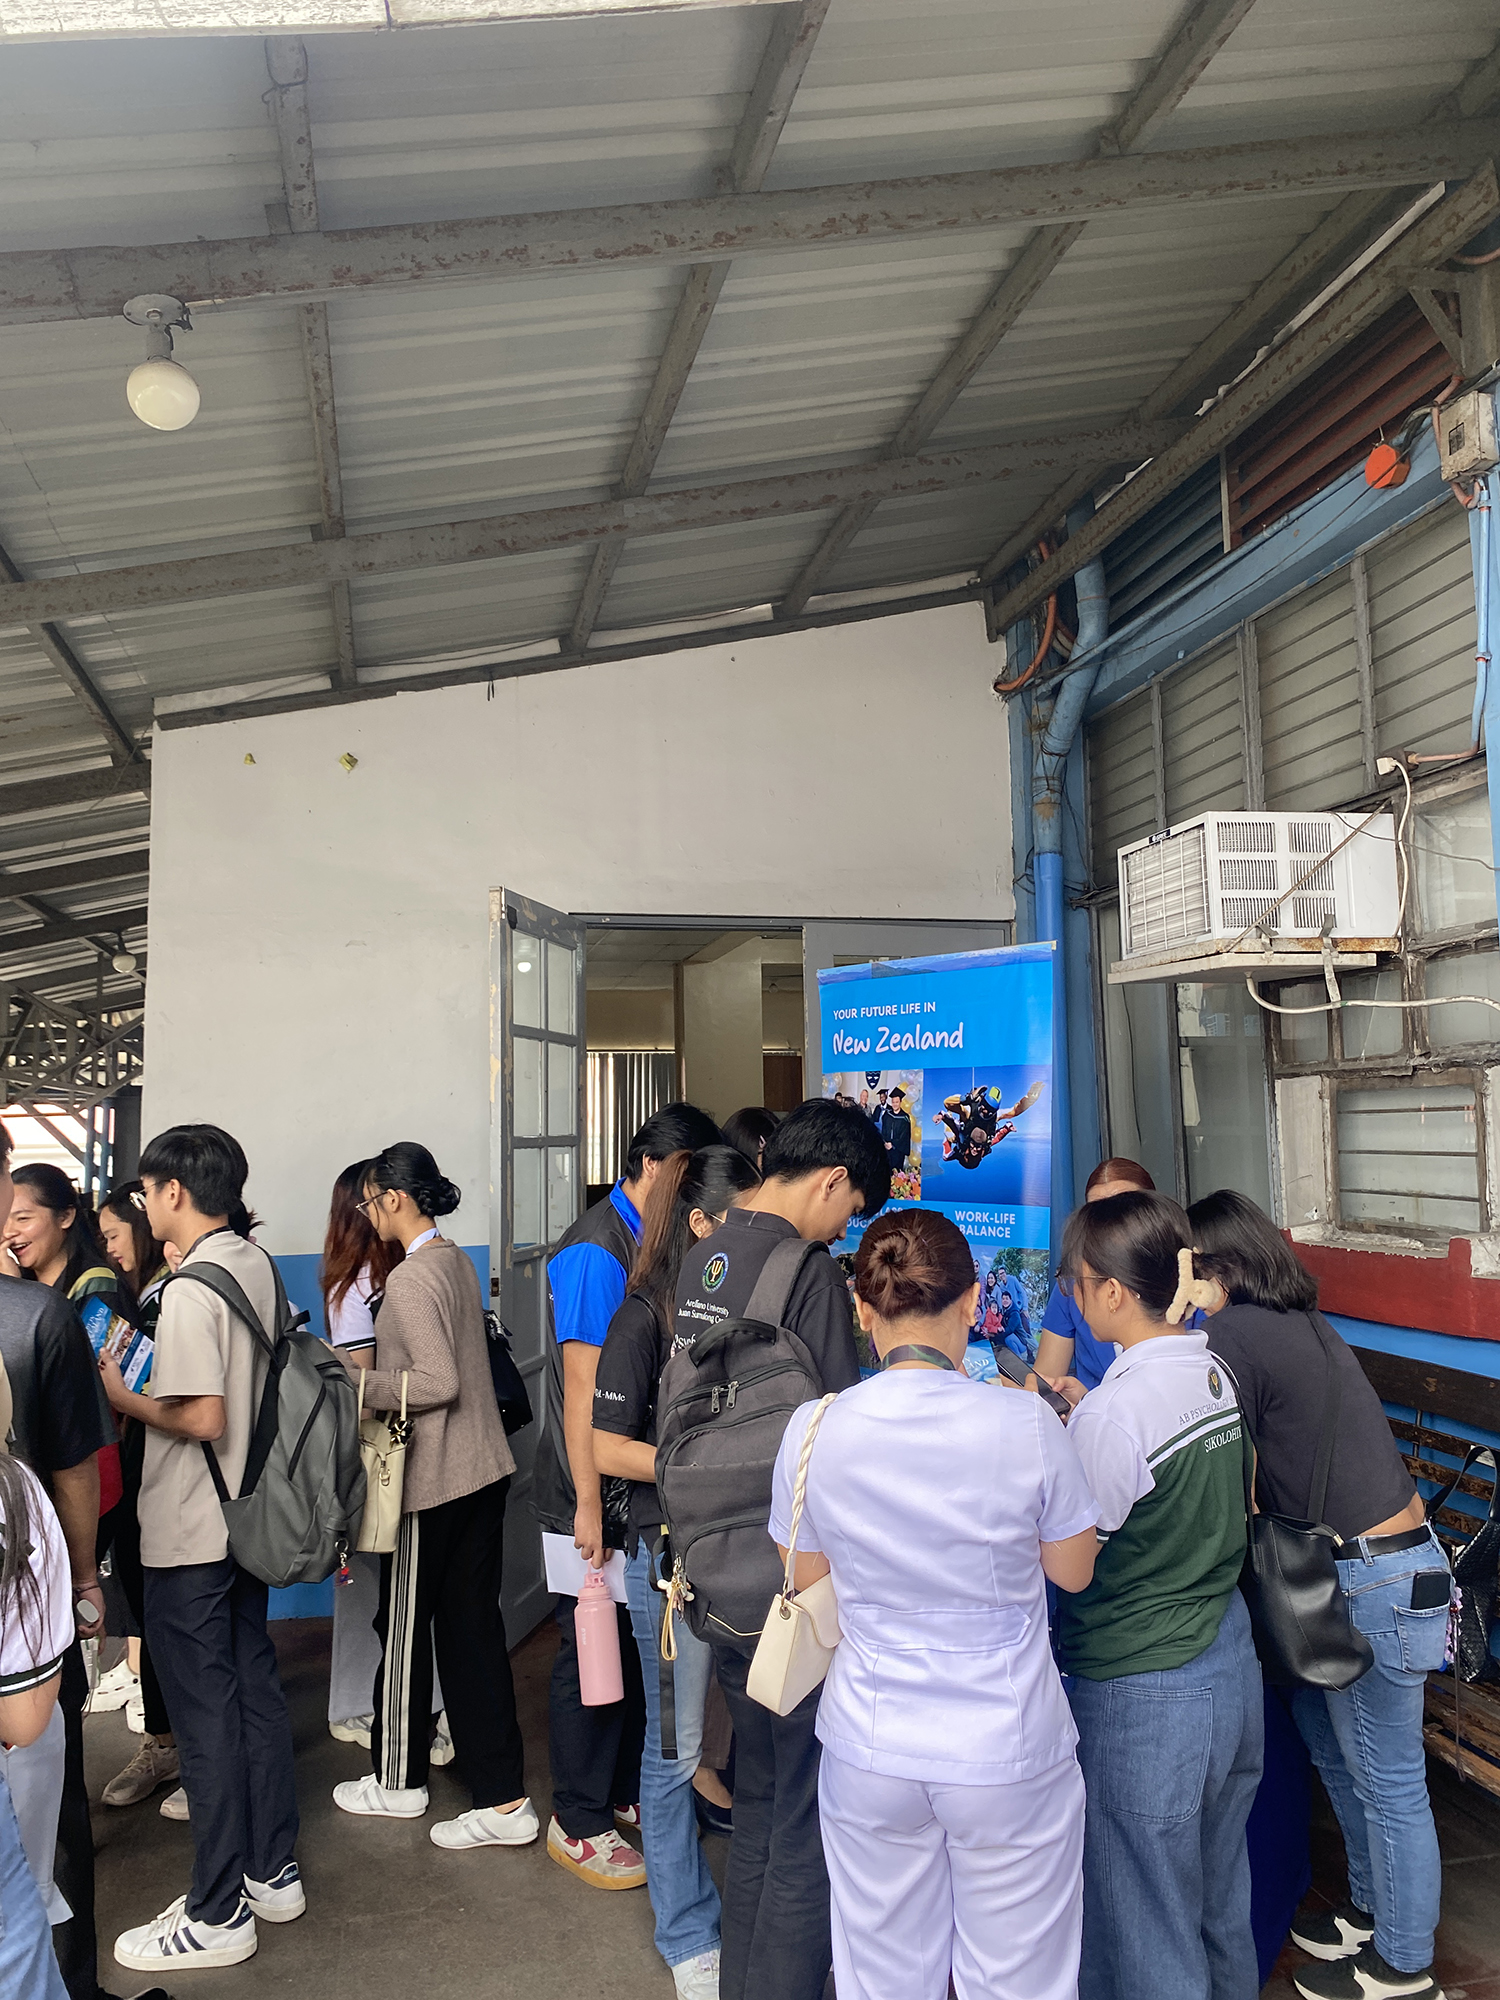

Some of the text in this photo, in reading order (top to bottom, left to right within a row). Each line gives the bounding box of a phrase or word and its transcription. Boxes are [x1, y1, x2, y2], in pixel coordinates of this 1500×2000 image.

[833, 1001, 936, 1020] YOUR FUTURE LIFE IN
[833, 1021, 964, 1055] New Zealand
[955, 1210, 1016, 1225] WORK-LIFE
[959, 1224, 1011, 1238] BALANCE
[677, 1308, 691, 1318] Juan
[706, 1302, 729, 1318] University
[1179, 1412, 1190, 1425] AB
[1190, 1397, 1230, 1419] PSYCHOLOGY
